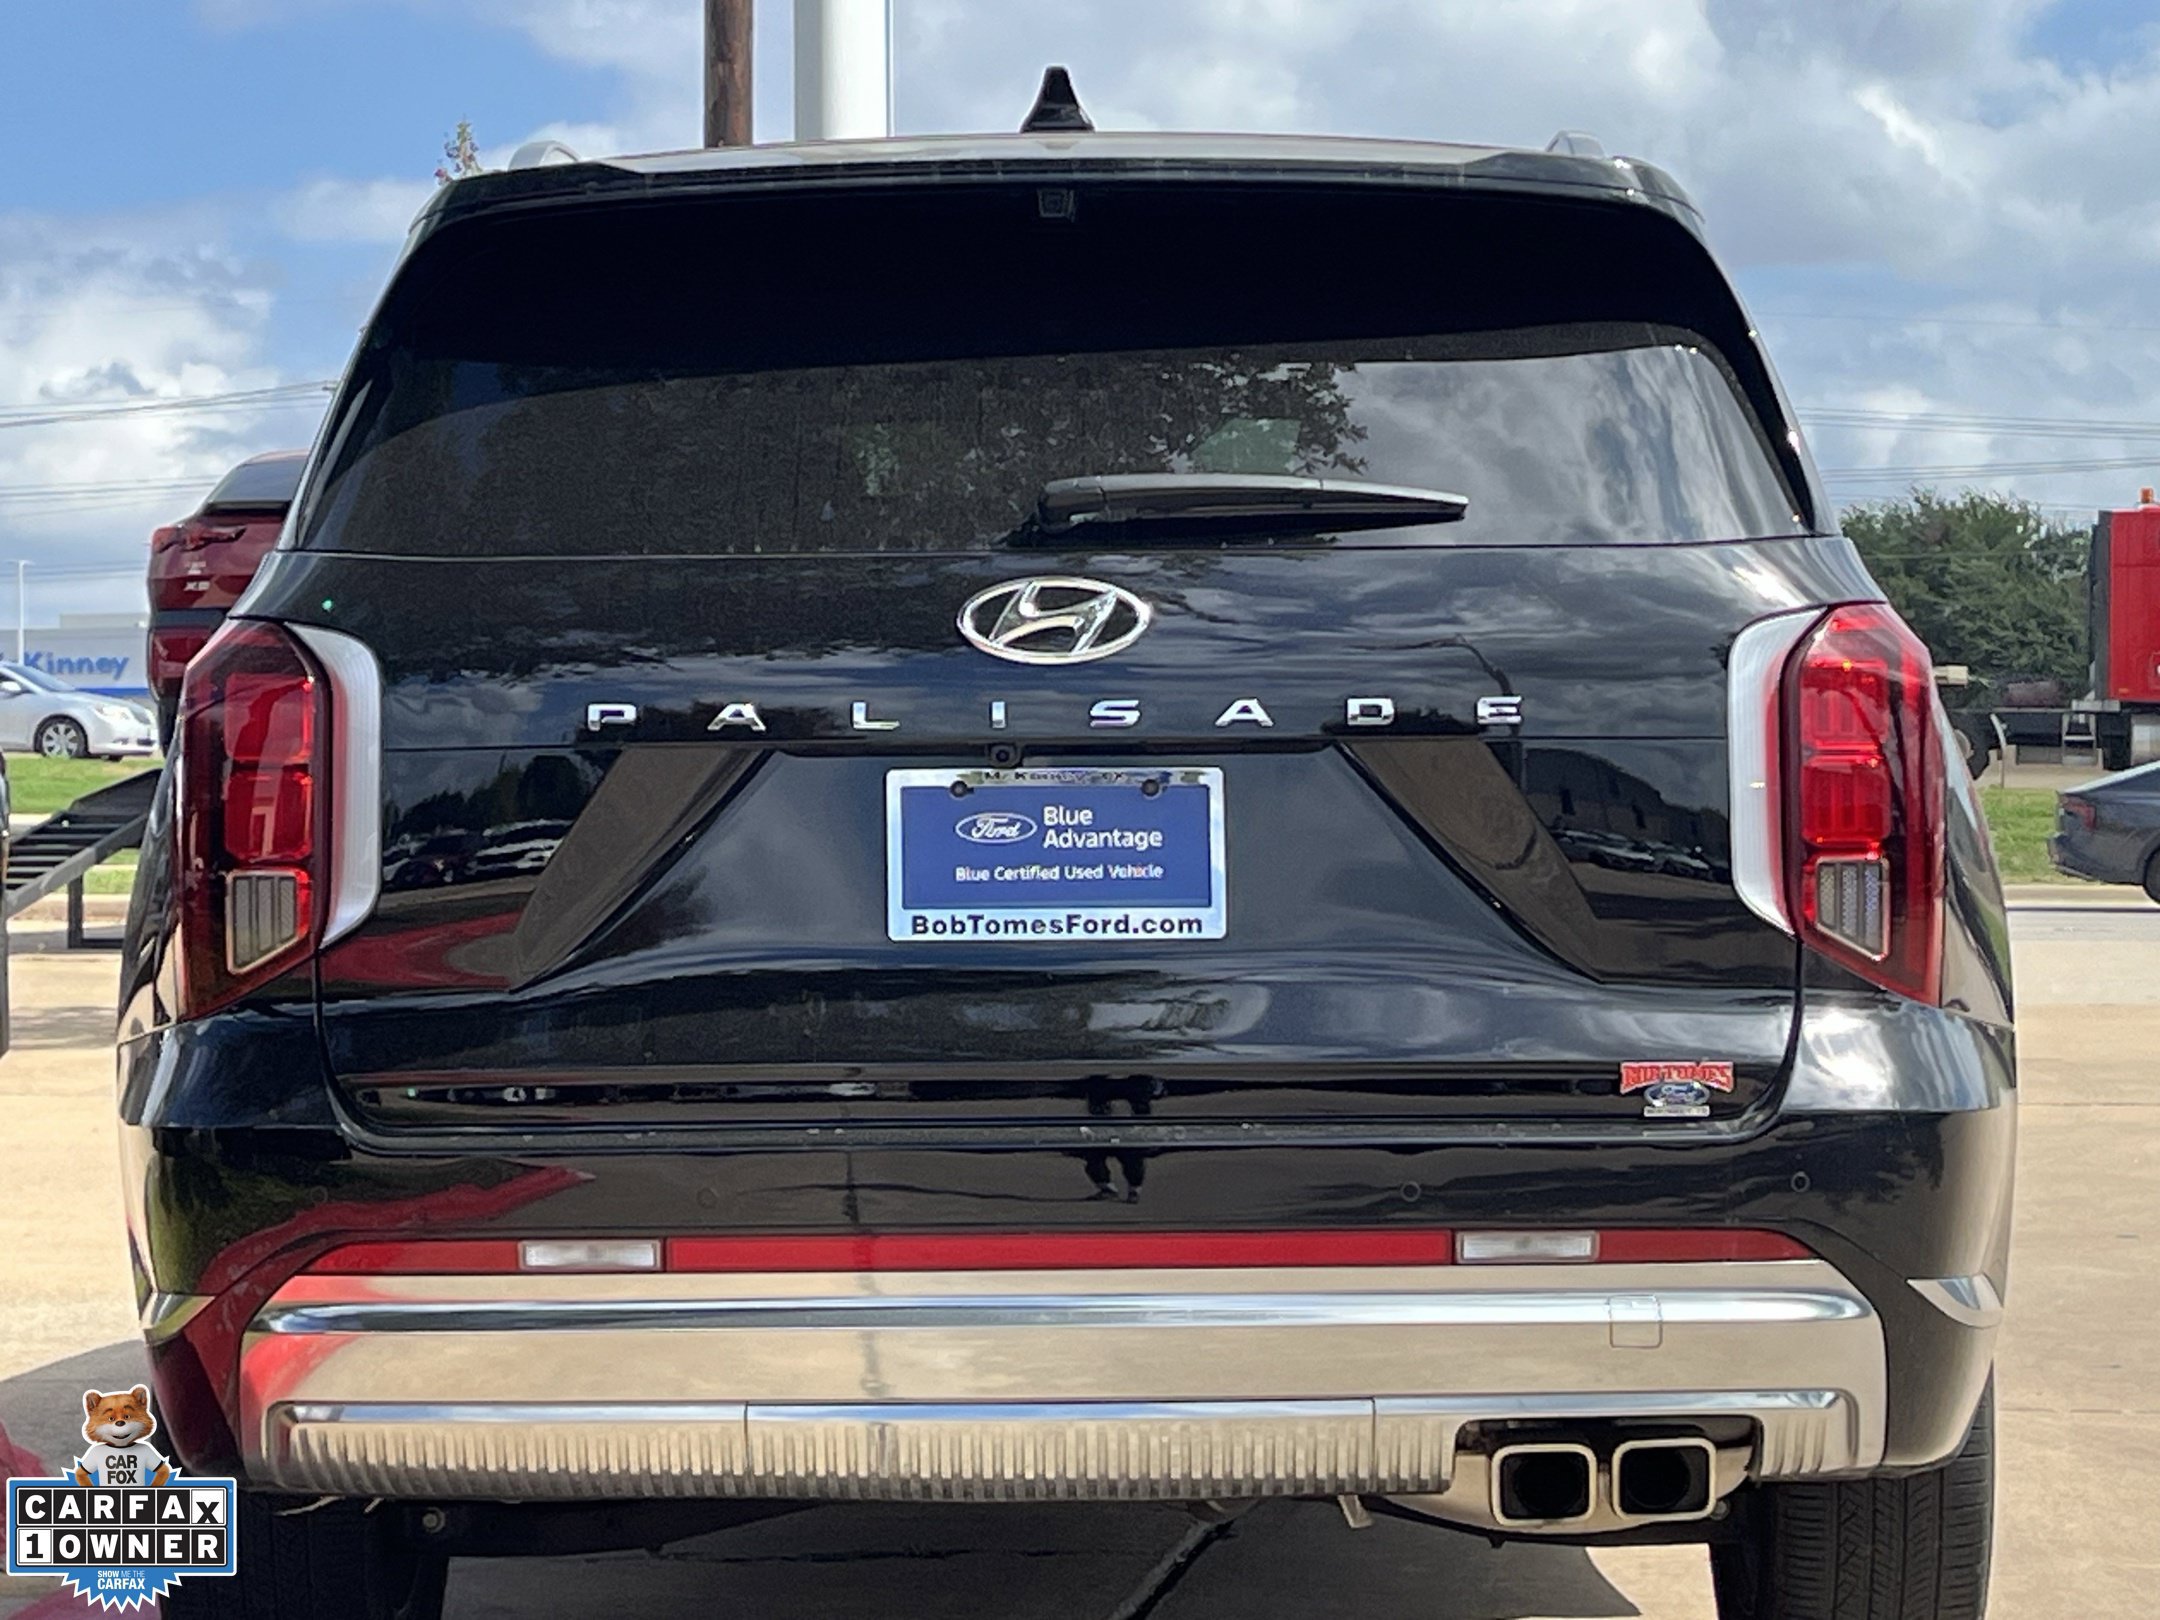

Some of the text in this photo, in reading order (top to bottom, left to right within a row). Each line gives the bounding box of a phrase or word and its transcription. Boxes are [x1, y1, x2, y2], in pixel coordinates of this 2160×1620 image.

[587, 696, 1522, 732] PALISADE
[971, 814, 1021, 838] Ford
[1043, 805, 1093, 826] Blue
[1042, 828, 1163, 851] Advantage
[955, 862, 1164, 881] Blue Certified Used Vehicle
[911, 913, 1203, 936] BobTomesFord.com
